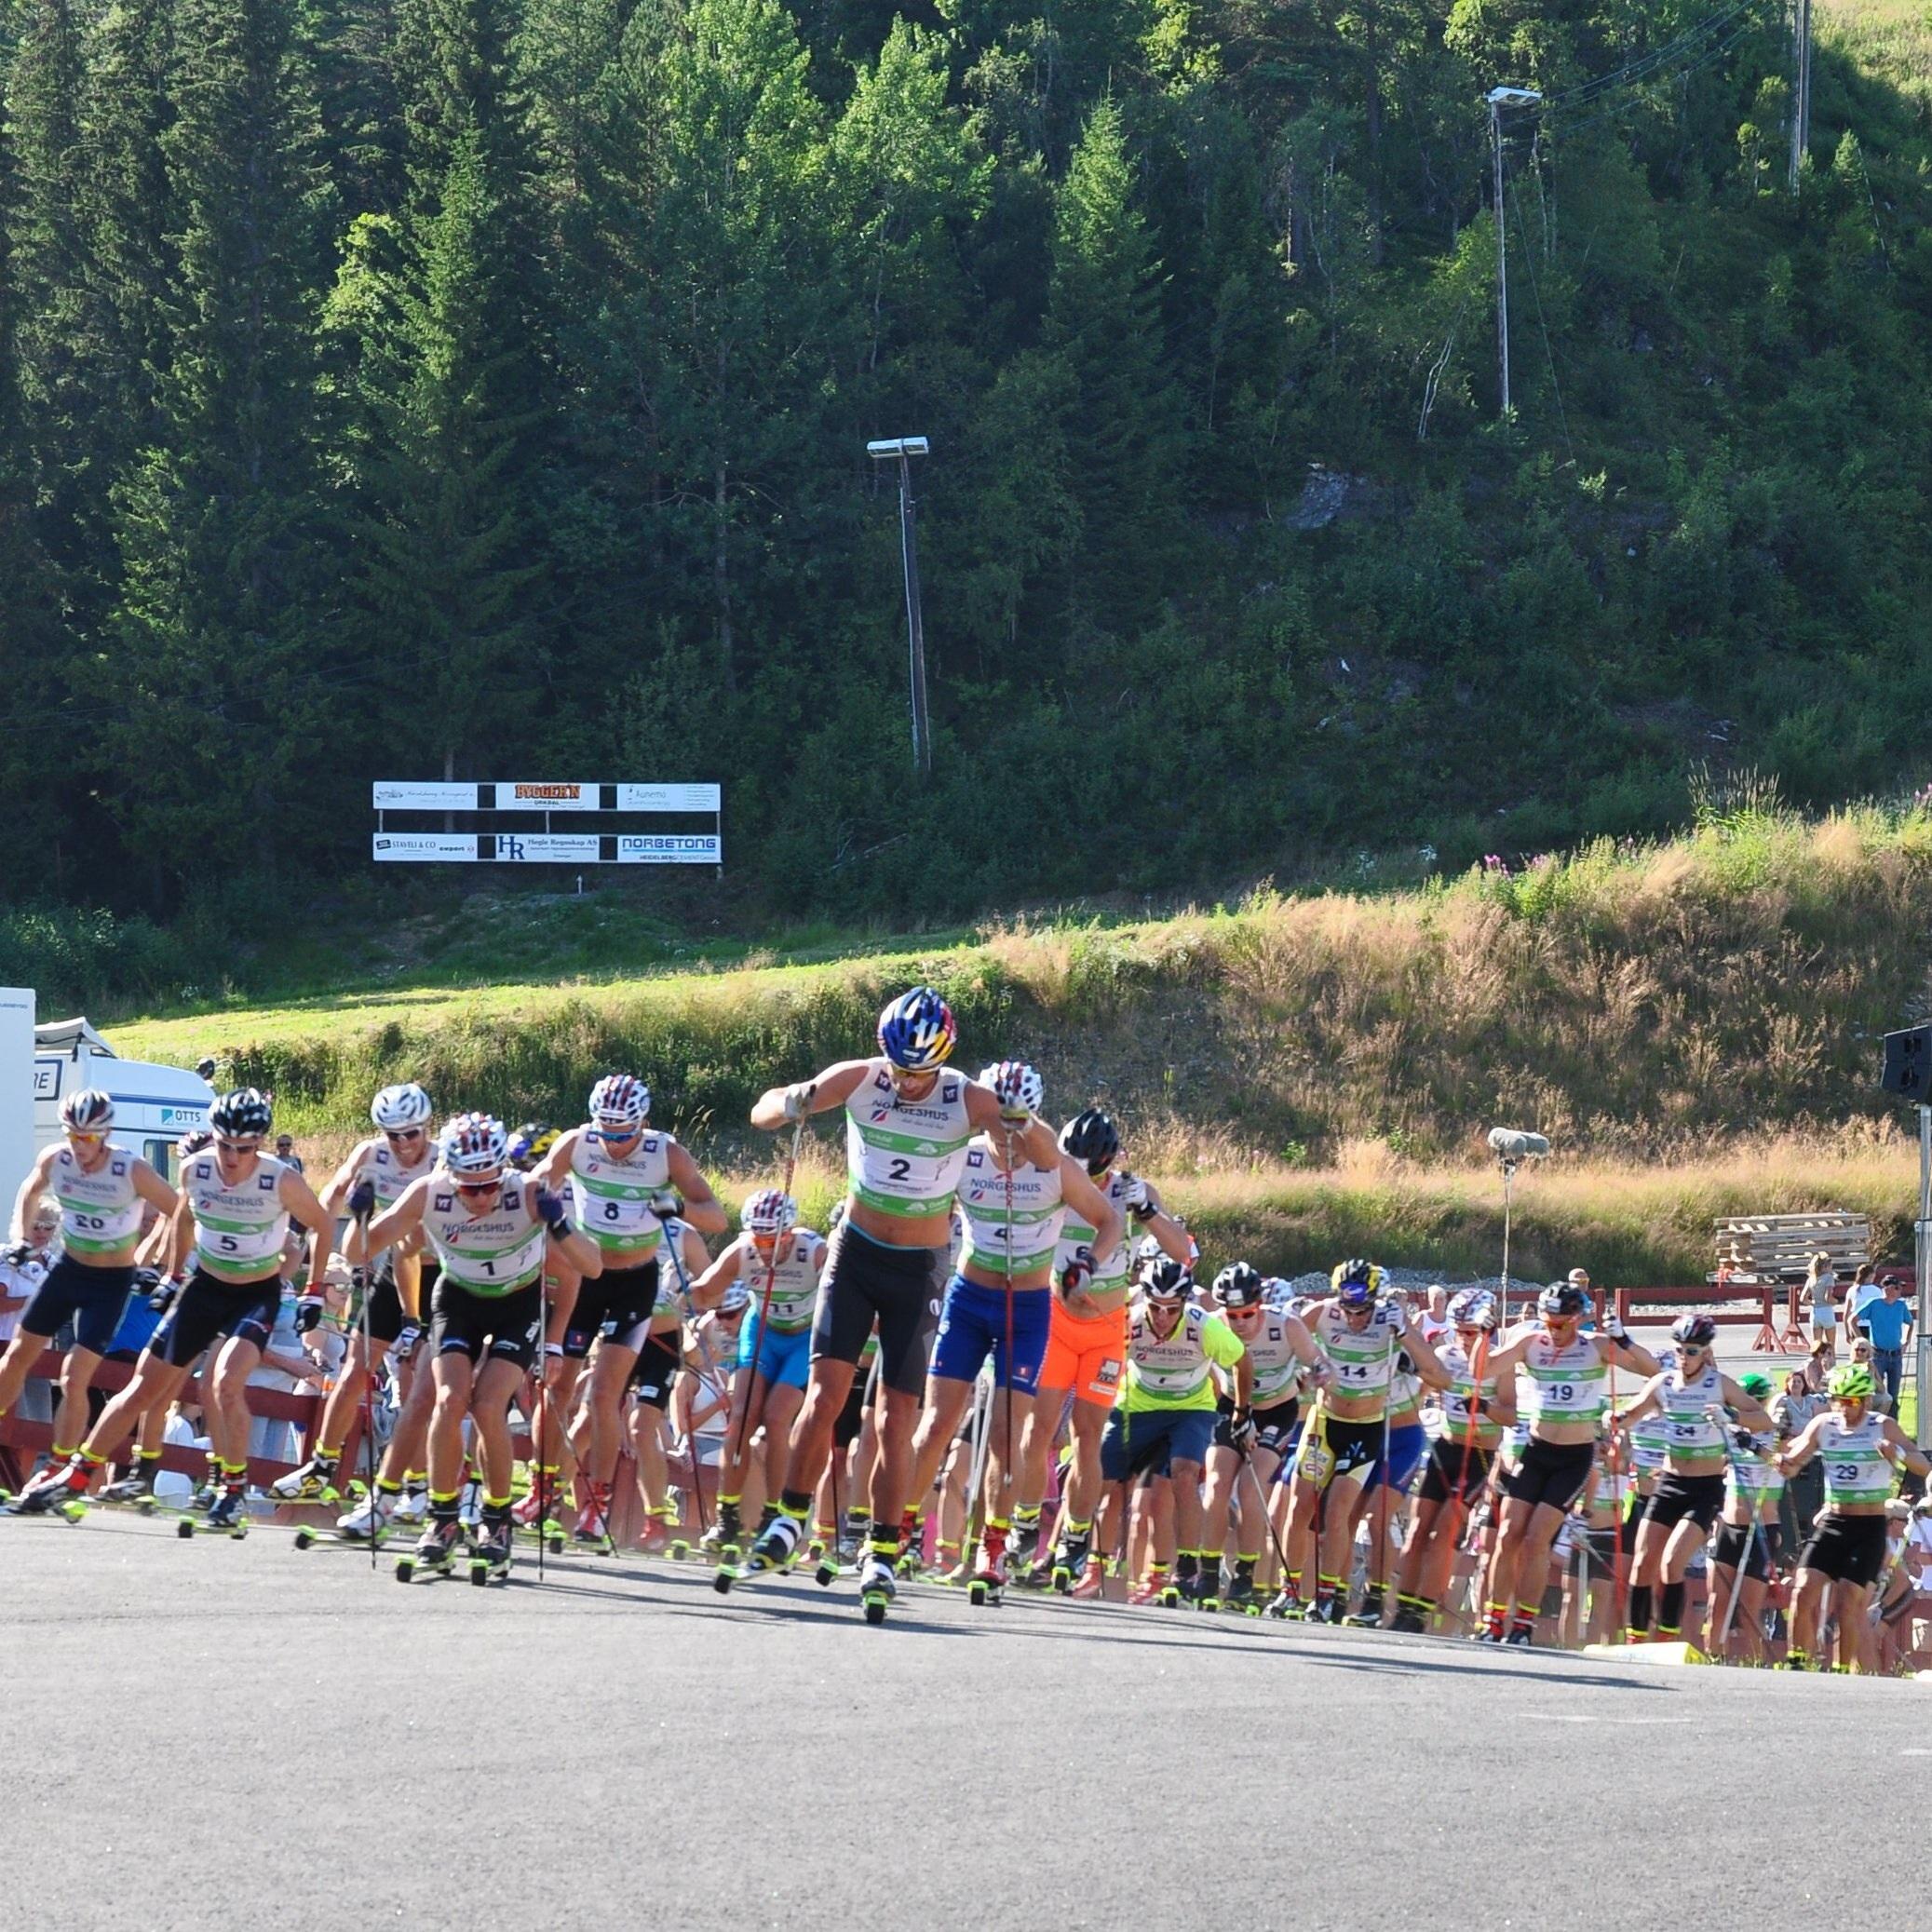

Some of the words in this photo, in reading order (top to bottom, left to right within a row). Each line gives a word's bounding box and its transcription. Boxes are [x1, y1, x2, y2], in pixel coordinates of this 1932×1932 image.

[515, 784, 581, 799] BYGGER'N
[622, 838, 716, 848] NORBETONG
[175, 1110, 201, 1123] OTTS
[871, 1099, 949, 1121] NORGESHUS
[888, 1158, 911, 1182] 2
[604, 1202, 619, 1220] 8
[75, 1214, 104, 1229] 20
[442, 1222, 515, 1234] NORGESHUS
[993, 1227, 1014, 1241] 4
[220, 1235, 238, 1251] 5
[480, 1261, 495, 1277] 1
[1340, 1365, 1368, 1378] 14
[1548, 1385, 1574, 1401] 19
[1674, 1425, 1696, 1437] 24
[1835, 1465, 1858, 1480] 29
